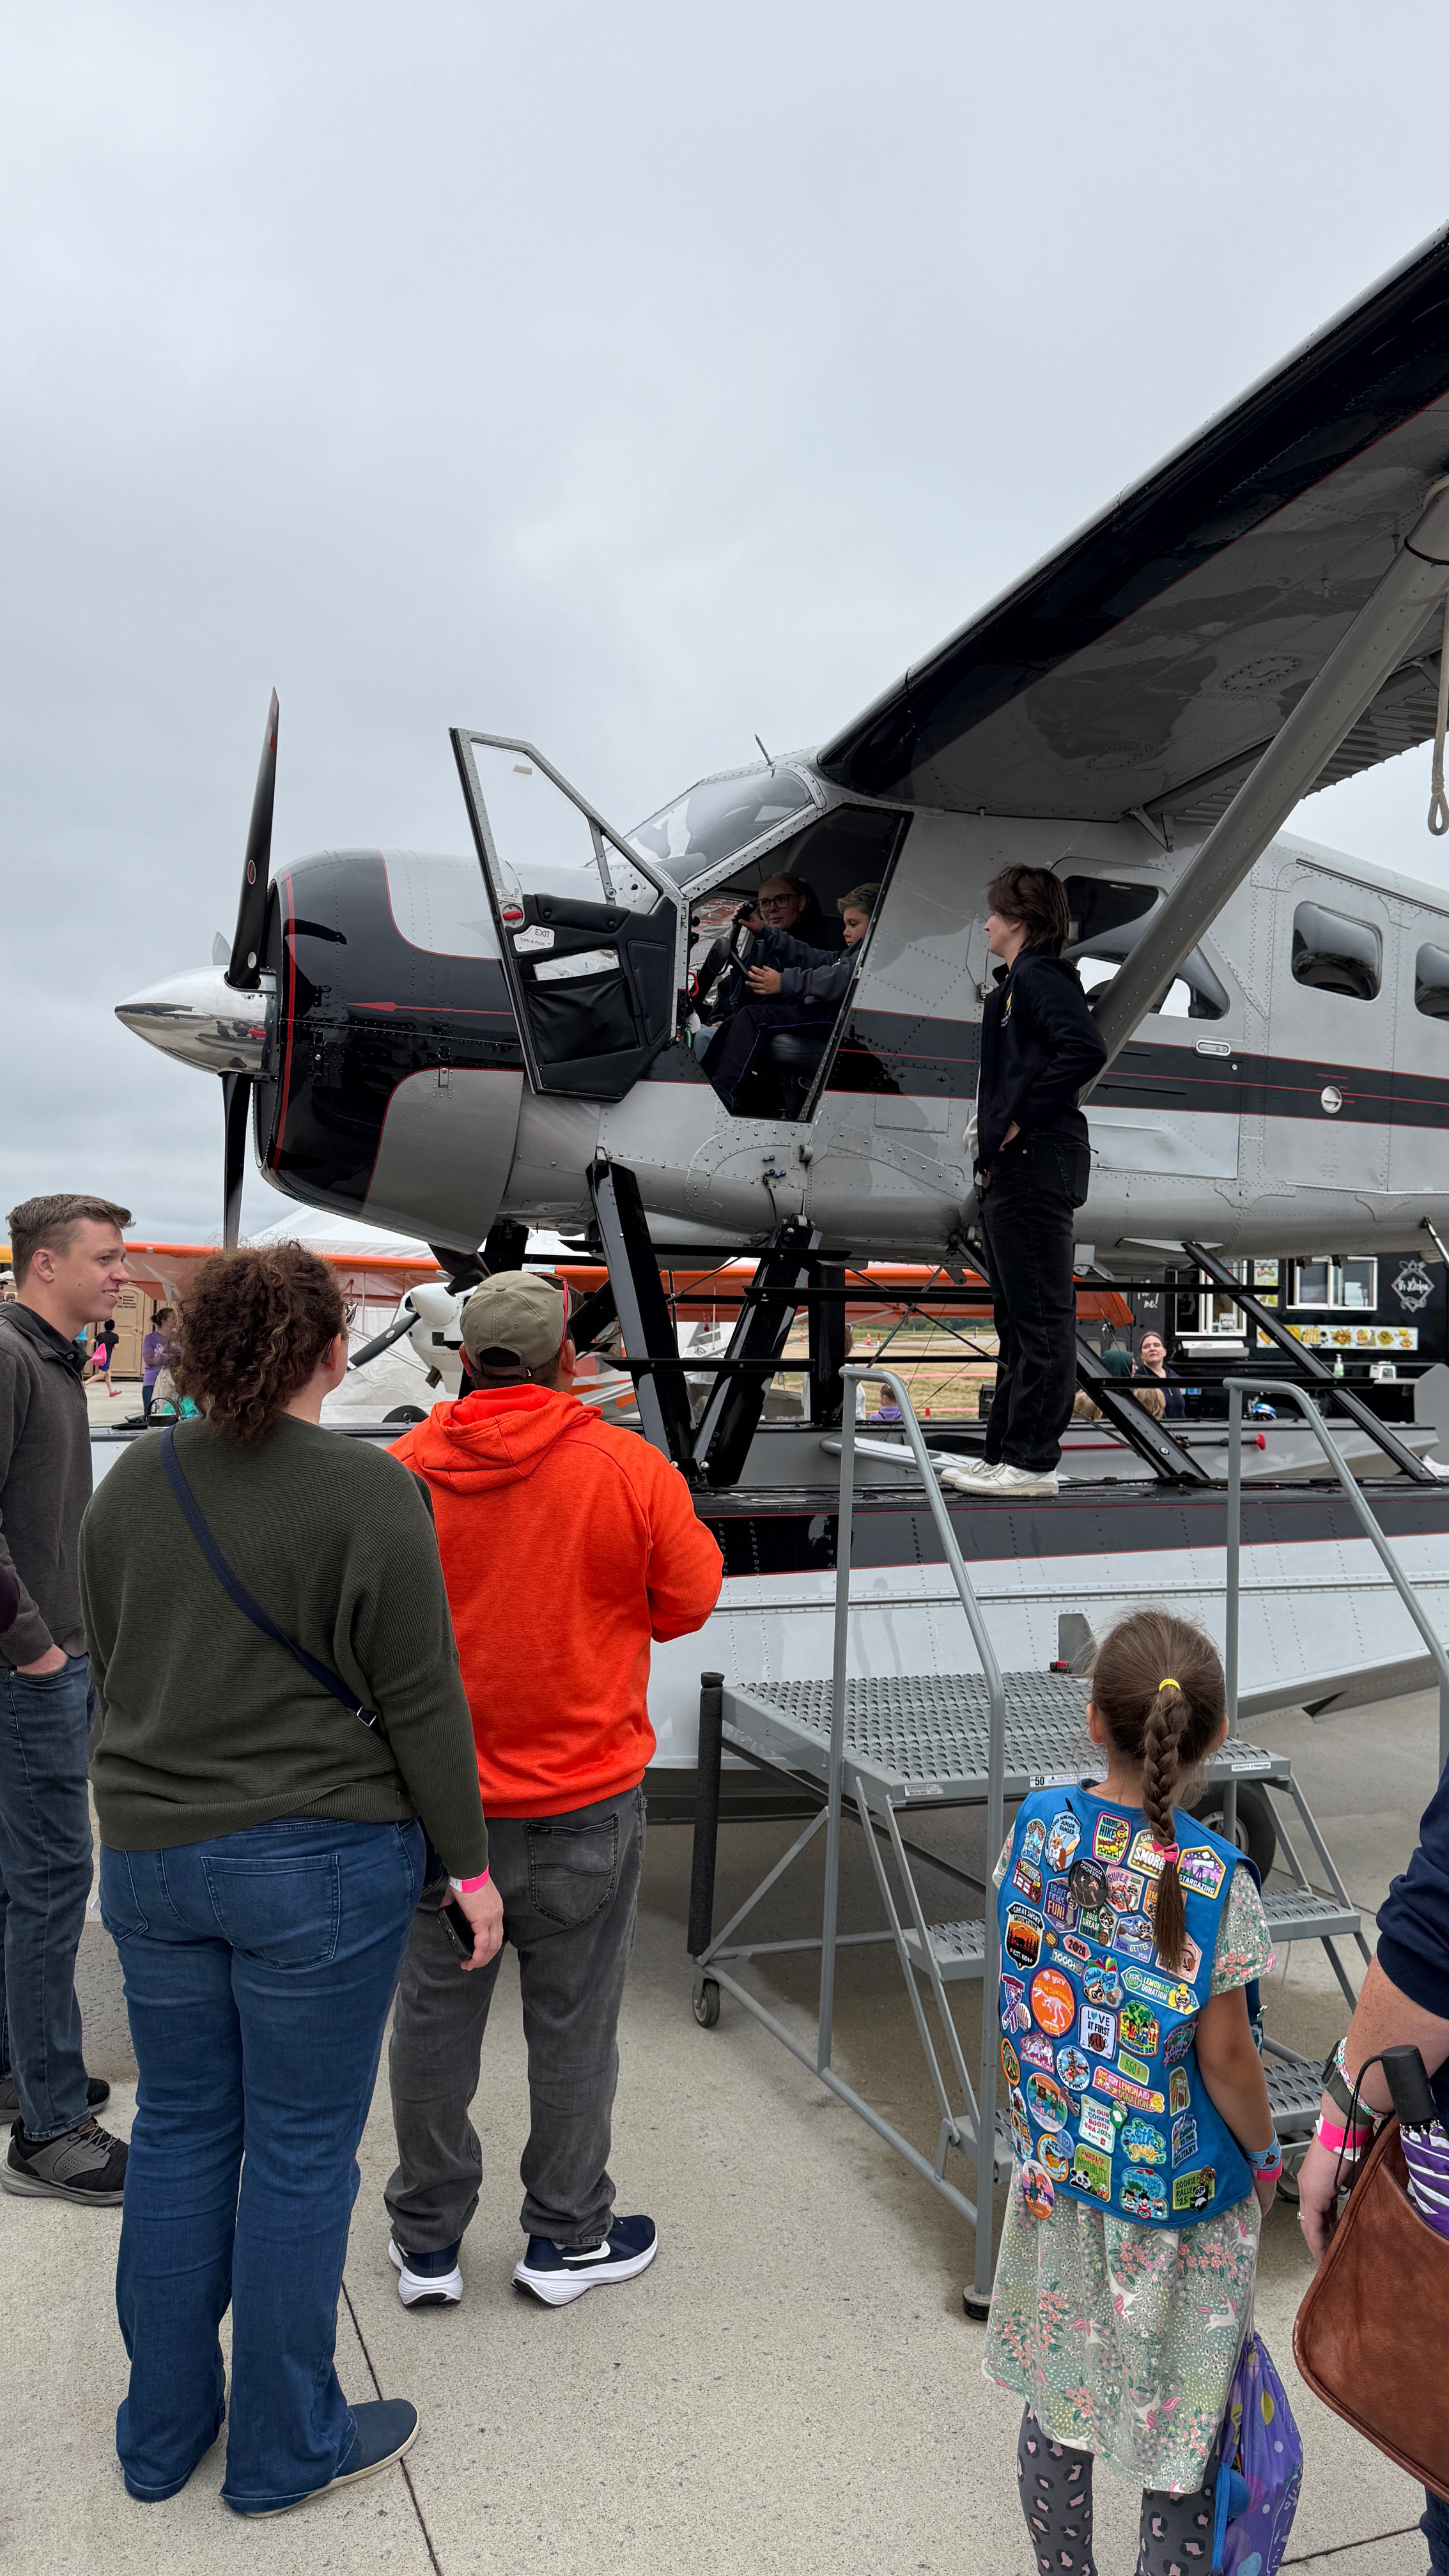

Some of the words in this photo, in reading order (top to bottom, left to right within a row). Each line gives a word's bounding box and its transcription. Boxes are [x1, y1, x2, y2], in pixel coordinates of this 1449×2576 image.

[535, 929, 550, 938] EXIT
[1035, 1776, 1045, 1786] 50
[1059, 1825, 1074, 1835] RANGER
[1061, 1820, 1075, 1828] JUNIOR
[1099, 1824, 1116, 1840] HIKE
[1140, 1833, 1154, 1842] GIRL
[1080, 1863, 1101, 1881] ORCHESTRA
[1081, 1859, 1103, 1876] MINNESOTA
[1107, 1871, 1129, 1883] SUPER
[1179, 1874, 1215, 1895] STARGAZING
[1013, 1906, 1027, 1916] GREAT
[1027, 1910, 1041, 1925] SMOKY
[1047, 1900, 1065, 1920] FUN!
[1014, 1915, 1038, 1931] MOUNTAINS
[1082, 1918, 1099, 1931] DREAM
[1115, 1939, 1129, 1951] GOAL
[1129, 1943, 1149, 1952] GETTER
[1053, 1951, 1076, 1970] 1000+
[1051, 1976, 1065, 1986] gsrv
[1143, 1977, 1170, 1993] LEMONAID
[1141, 1983, 1168, 2001] DONATION
[1087, 2021, 1094, 2030] AT
[1094, 2023, 1110, 2037] FIRST
[1057, 2058, 1068, 2083] HOLIDAY
[1068, 2081, 1083, 2090] EVENT
[1118, 2089, 1149, 2109] DONATION
[1088, 2111, 1110, 2125] COOKIE
[1096, 2109, 1110, 2118] OUR
[1084, 2122, 1096, 2133] ERA
[1088, 2118, 1109, 2131] BOOTH
[1124, 2126, 1155, 2147] Earth
[1186, 2132, 1195, 2141] THE
[1174, 2143, 1196, 2166] MILITARY
[1176, 2177, 1196, 2190] COOKIE
[1176, 2185, 1193, 2198] RALLY
[1177, 2196, 1188, 2205] '25
